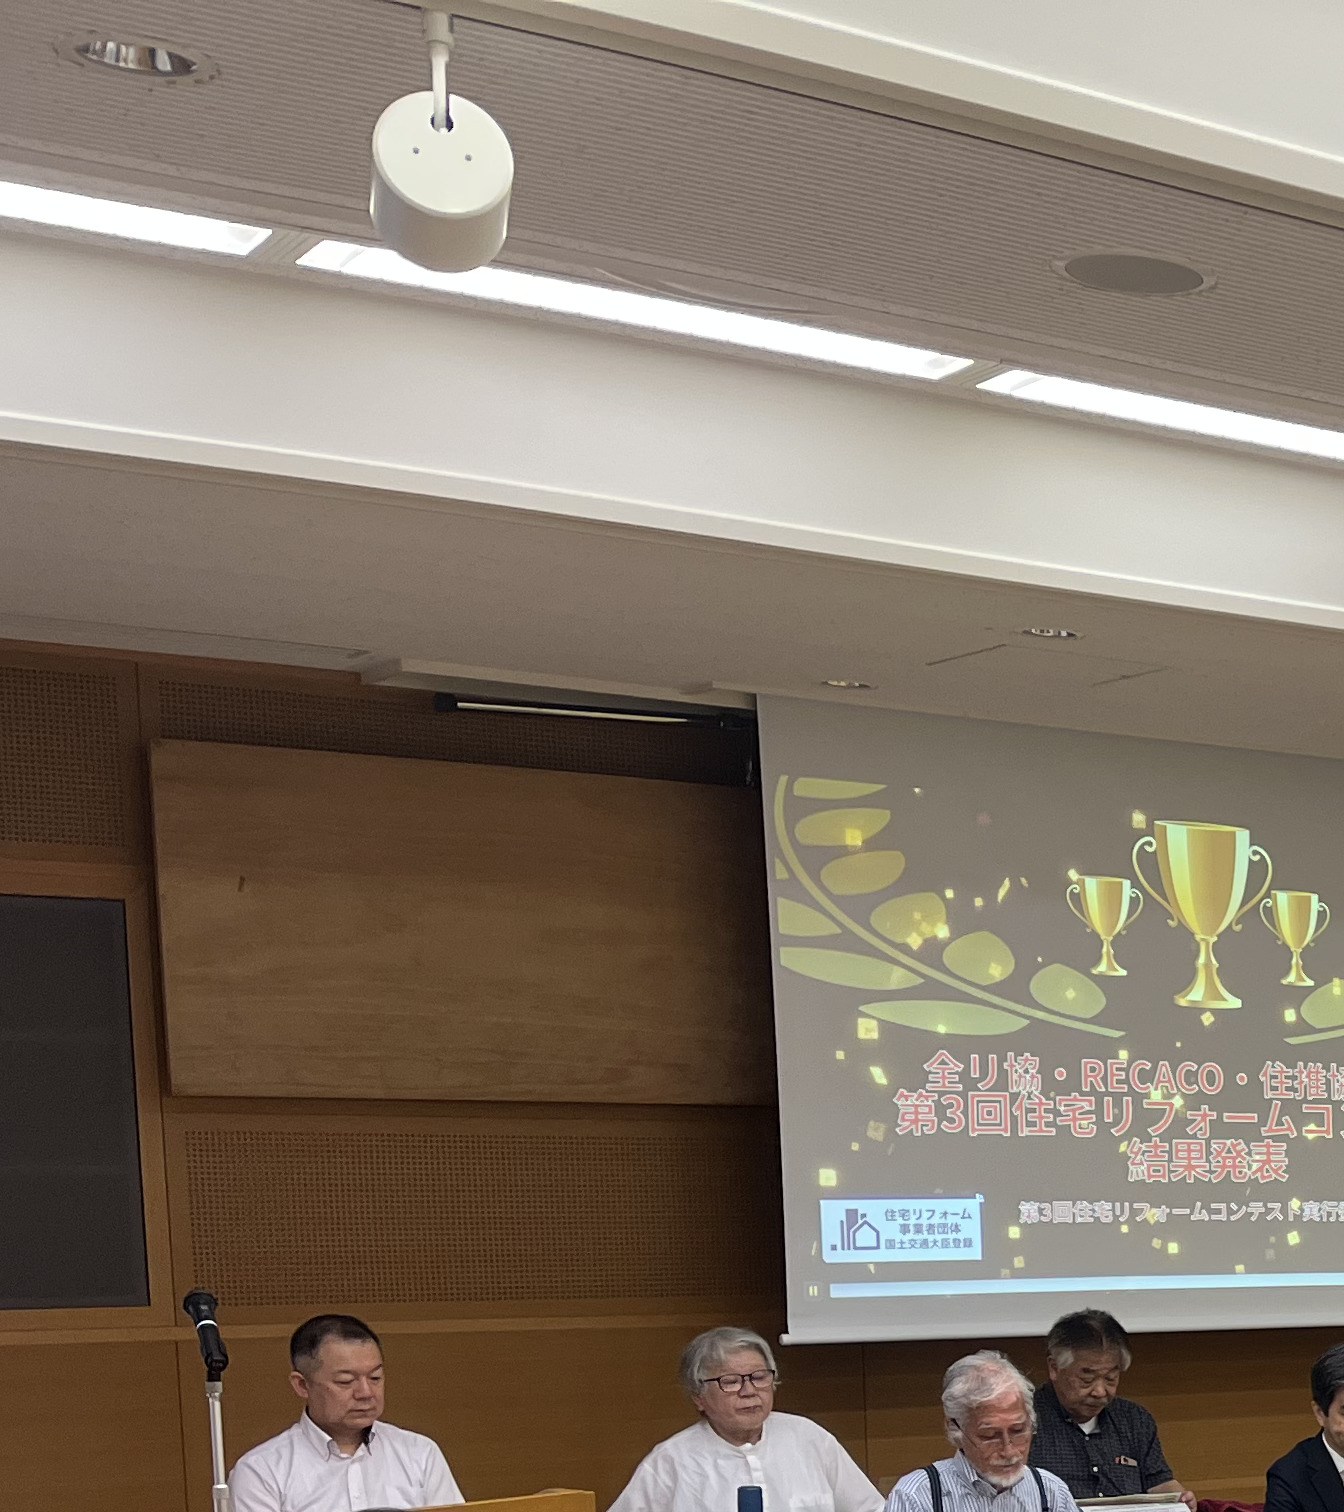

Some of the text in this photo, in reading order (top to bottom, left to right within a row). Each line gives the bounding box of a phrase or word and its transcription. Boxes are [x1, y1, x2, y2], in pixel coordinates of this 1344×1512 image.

[1127, 1137, 1289, 1183] 結果発表
[885, 1208, 973, 1221] 住宅リフォーム
[899, 1222, 962, 1236] 事業者団体
[885, 1237, 974, 1250] 国土交通大臣登録
